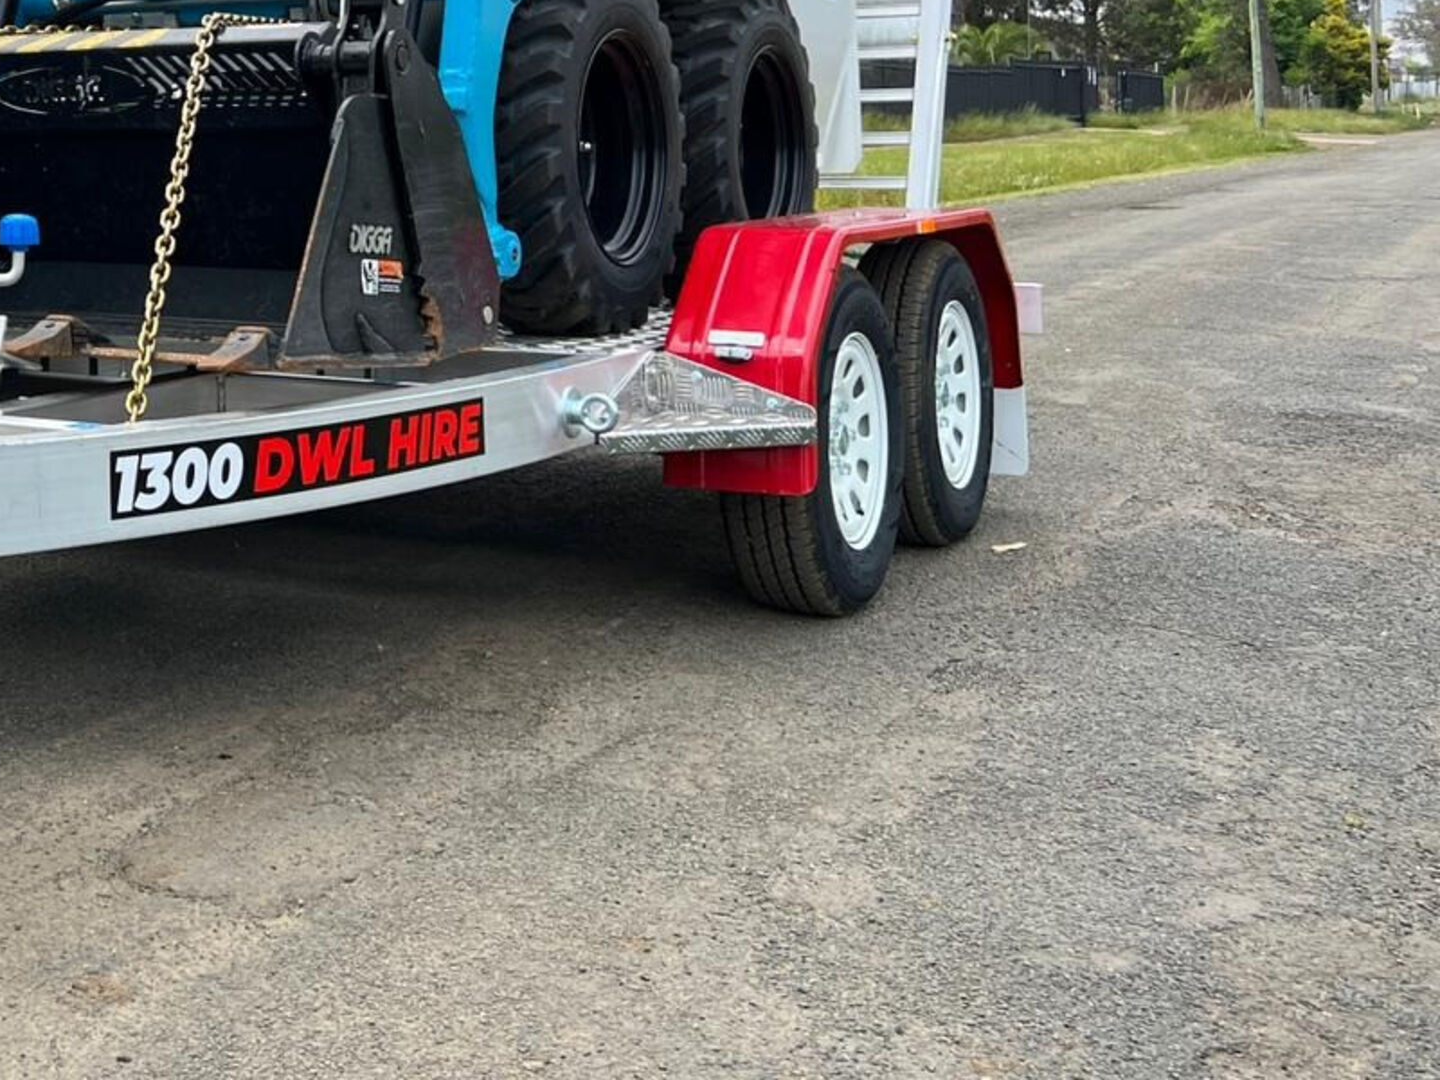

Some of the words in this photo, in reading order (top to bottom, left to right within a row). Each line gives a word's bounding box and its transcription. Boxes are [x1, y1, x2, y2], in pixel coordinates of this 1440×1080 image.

[349, 224, 393, 255] DIGGA
[114, 441, 244, 514] 1300
[253, 424, 375, 493] DWL
[388, 403, 482, 470] HIRE
